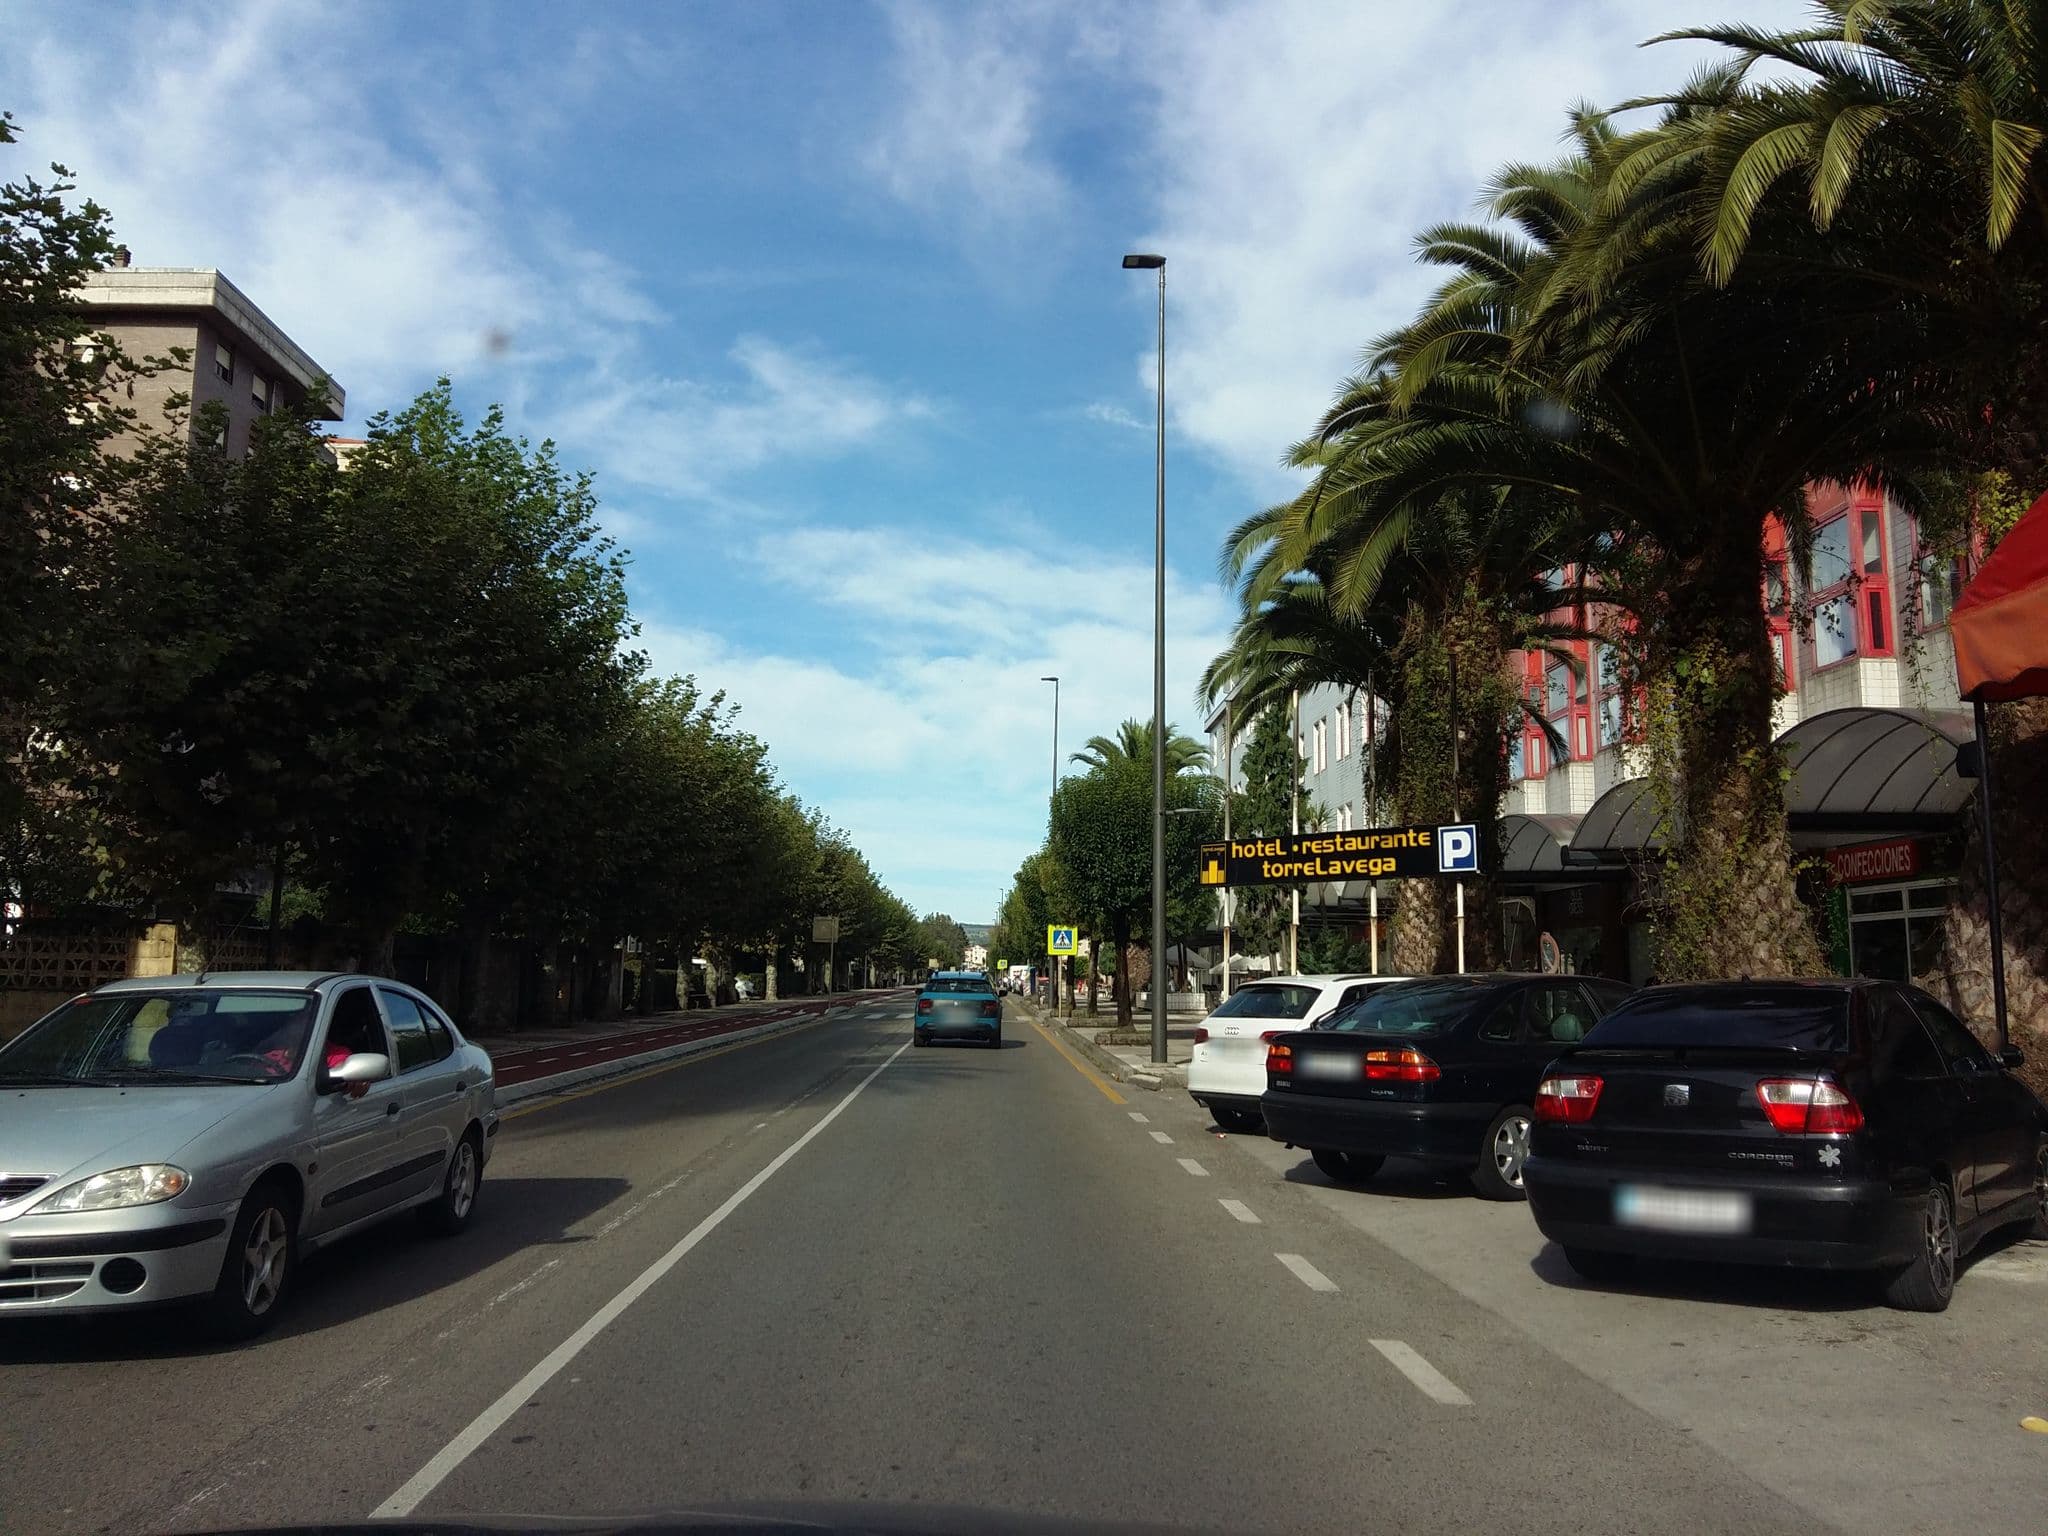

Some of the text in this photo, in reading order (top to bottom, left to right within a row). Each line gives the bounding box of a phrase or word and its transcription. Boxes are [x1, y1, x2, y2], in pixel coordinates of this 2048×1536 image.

[1302, 828, 1431, 854] restaurante
[1443, 831, 1471, 868] P
[1836, 845, 1911, 878] CONFECCIONES
[1727, 1152, 1794, 1161] CORDOBA
